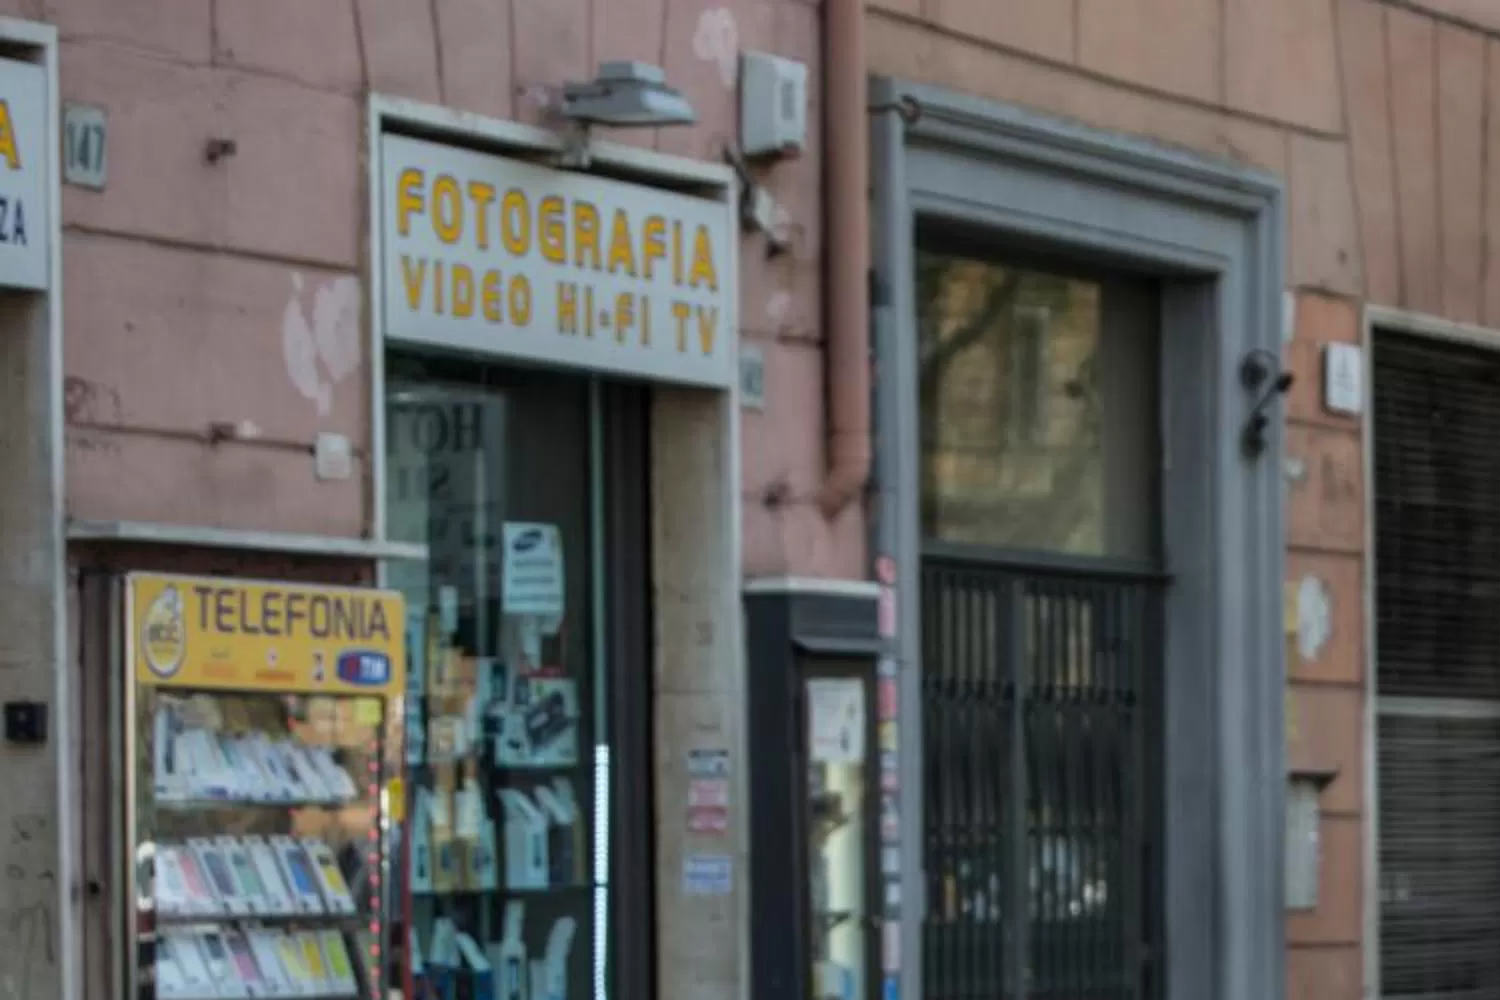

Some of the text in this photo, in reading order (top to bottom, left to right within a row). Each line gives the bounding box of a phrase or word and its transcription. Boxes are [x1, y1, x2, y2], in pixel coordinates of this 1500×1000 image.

[396, 168, 719, 292] FOTOGRAFIA
[401, 254, 718, 355] VIDEO HI-FI TV
[193, 585, 391, 641] TELEFONIA
